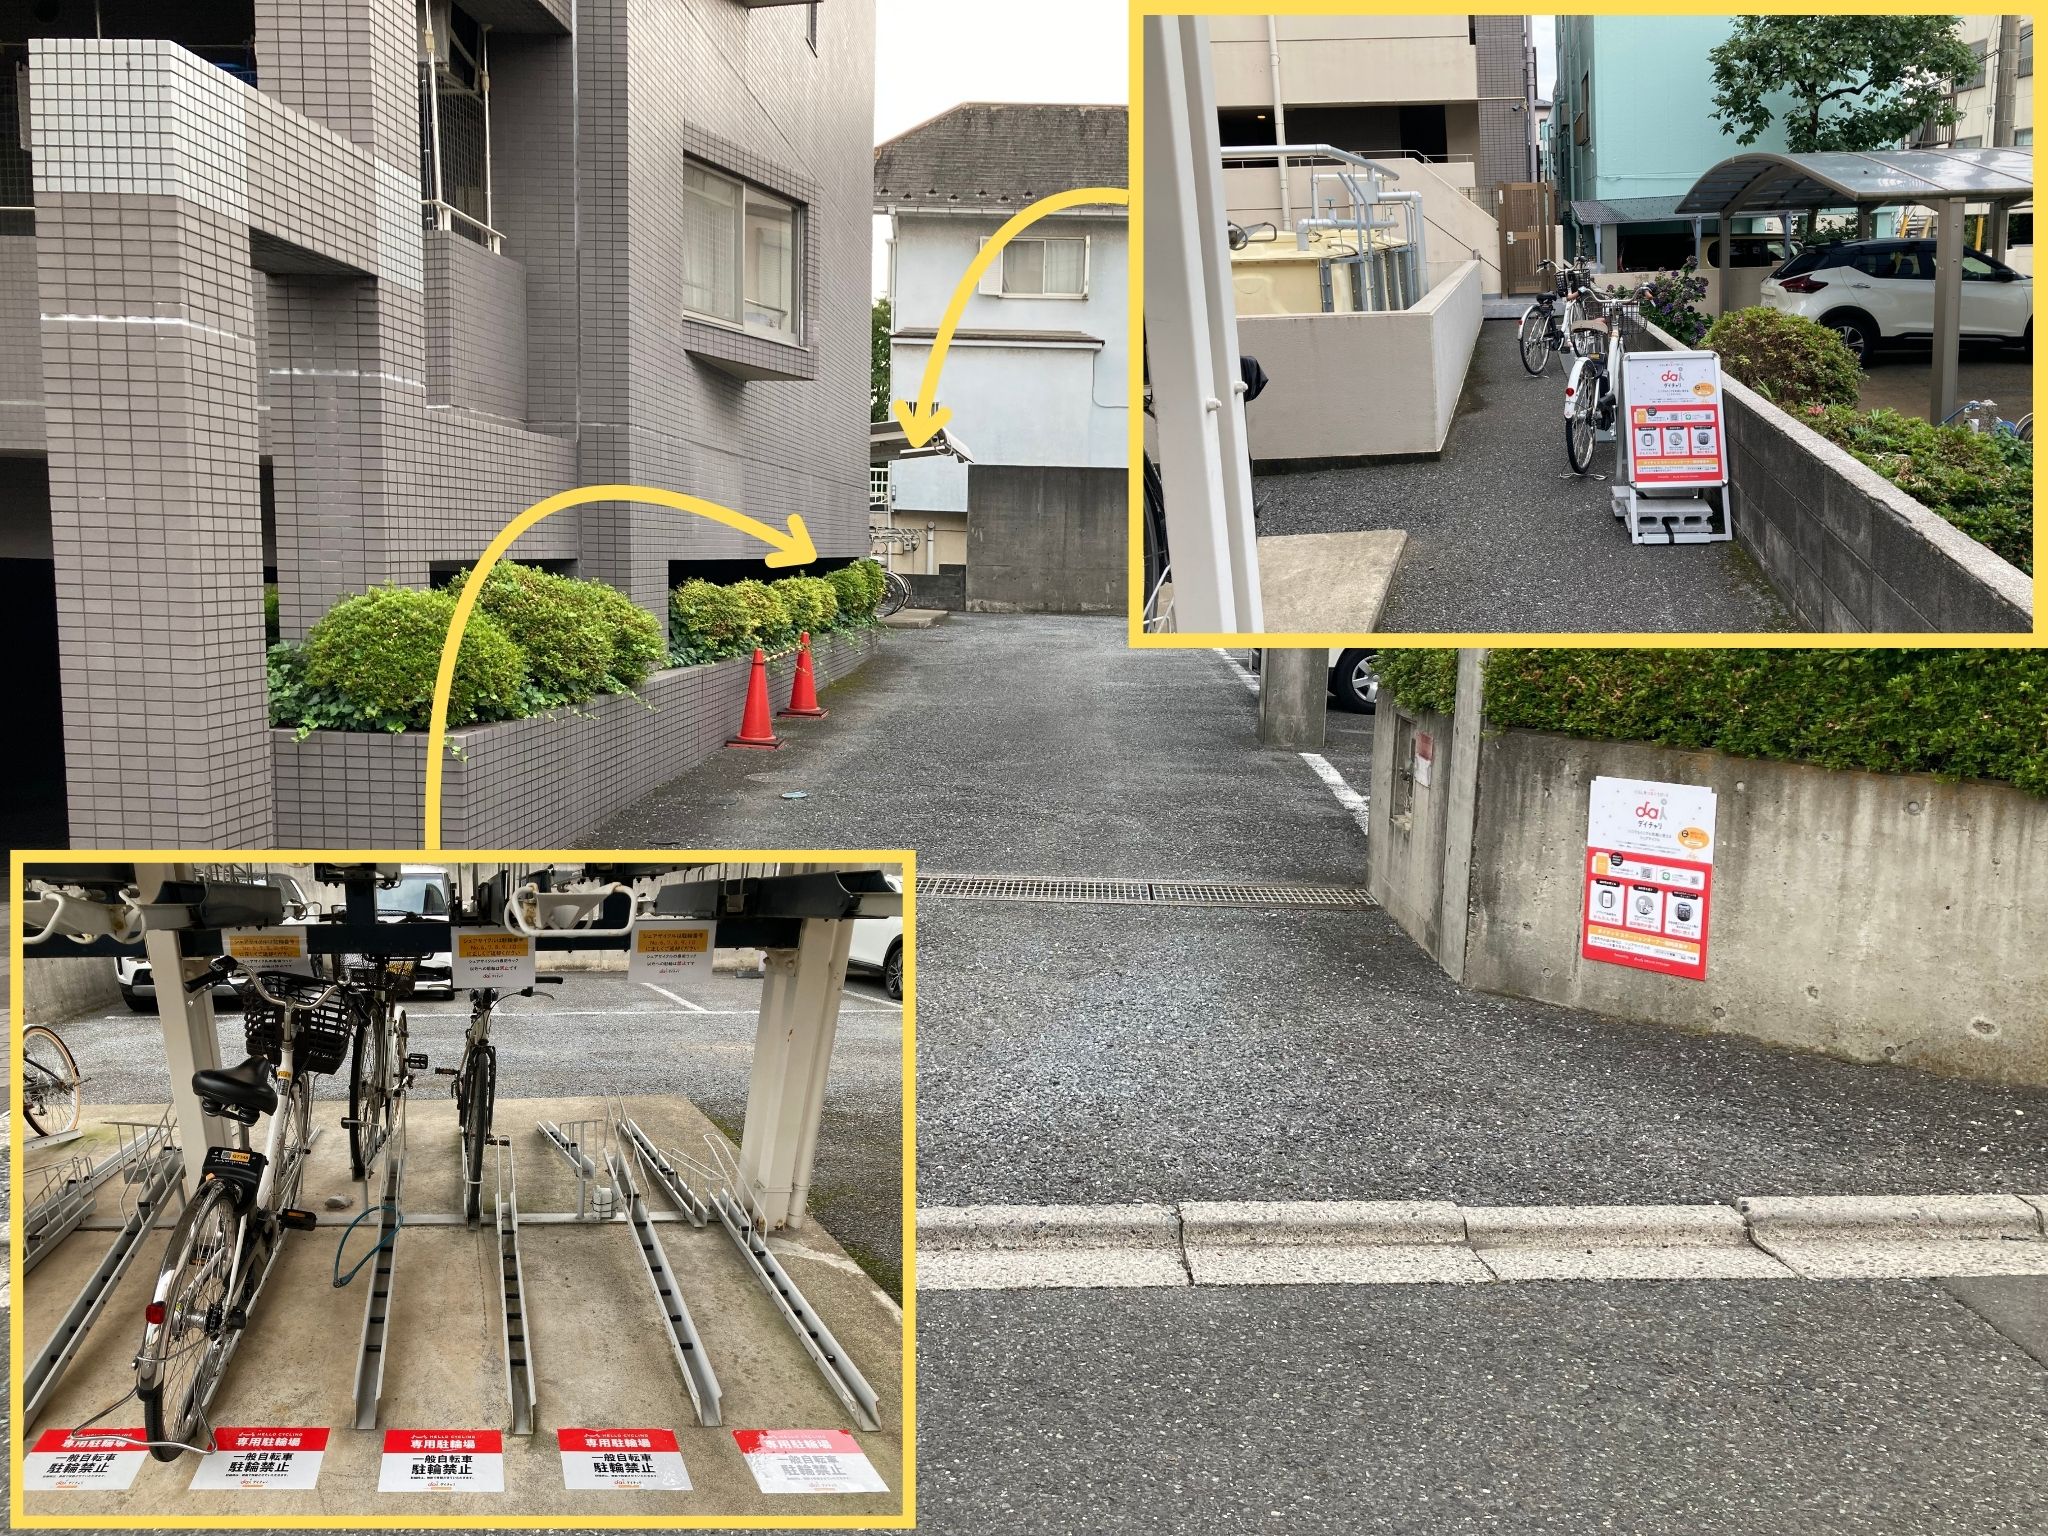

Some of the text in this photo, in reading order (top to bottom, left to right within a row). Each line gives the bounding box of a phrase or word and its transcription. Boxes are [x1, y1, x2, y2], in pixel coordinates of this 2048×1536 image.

[1637, 820, 1663, 830] ダイチャリ
[235, 1437, 302, 1447] 専用駐輪場
[410, 1439, 476, 1449] 専用駐輪場
[584, 1438, 651, 1448] 専用駐輪場
[56, 1453, 118, 1462] 一般自転車
[233, 1452, 295, 1461] 一般自転車
[412, 1455, 473, 1463] 一般自転車
[591, 1453, 653, 1462] 一般自転車
[776, 1455, 840, 1464] 一般自転車
[47, 1462, 110, 1474] 駐輪禁止
[228, 1461, 290, 1473] 駐輪禁止
[411, 1463, 473, 1475] 駐輪禁止
[593, 1462, 656, 1473] 駐輪禁止
[780, 1464, 847, 1476] 駐輪禁止
